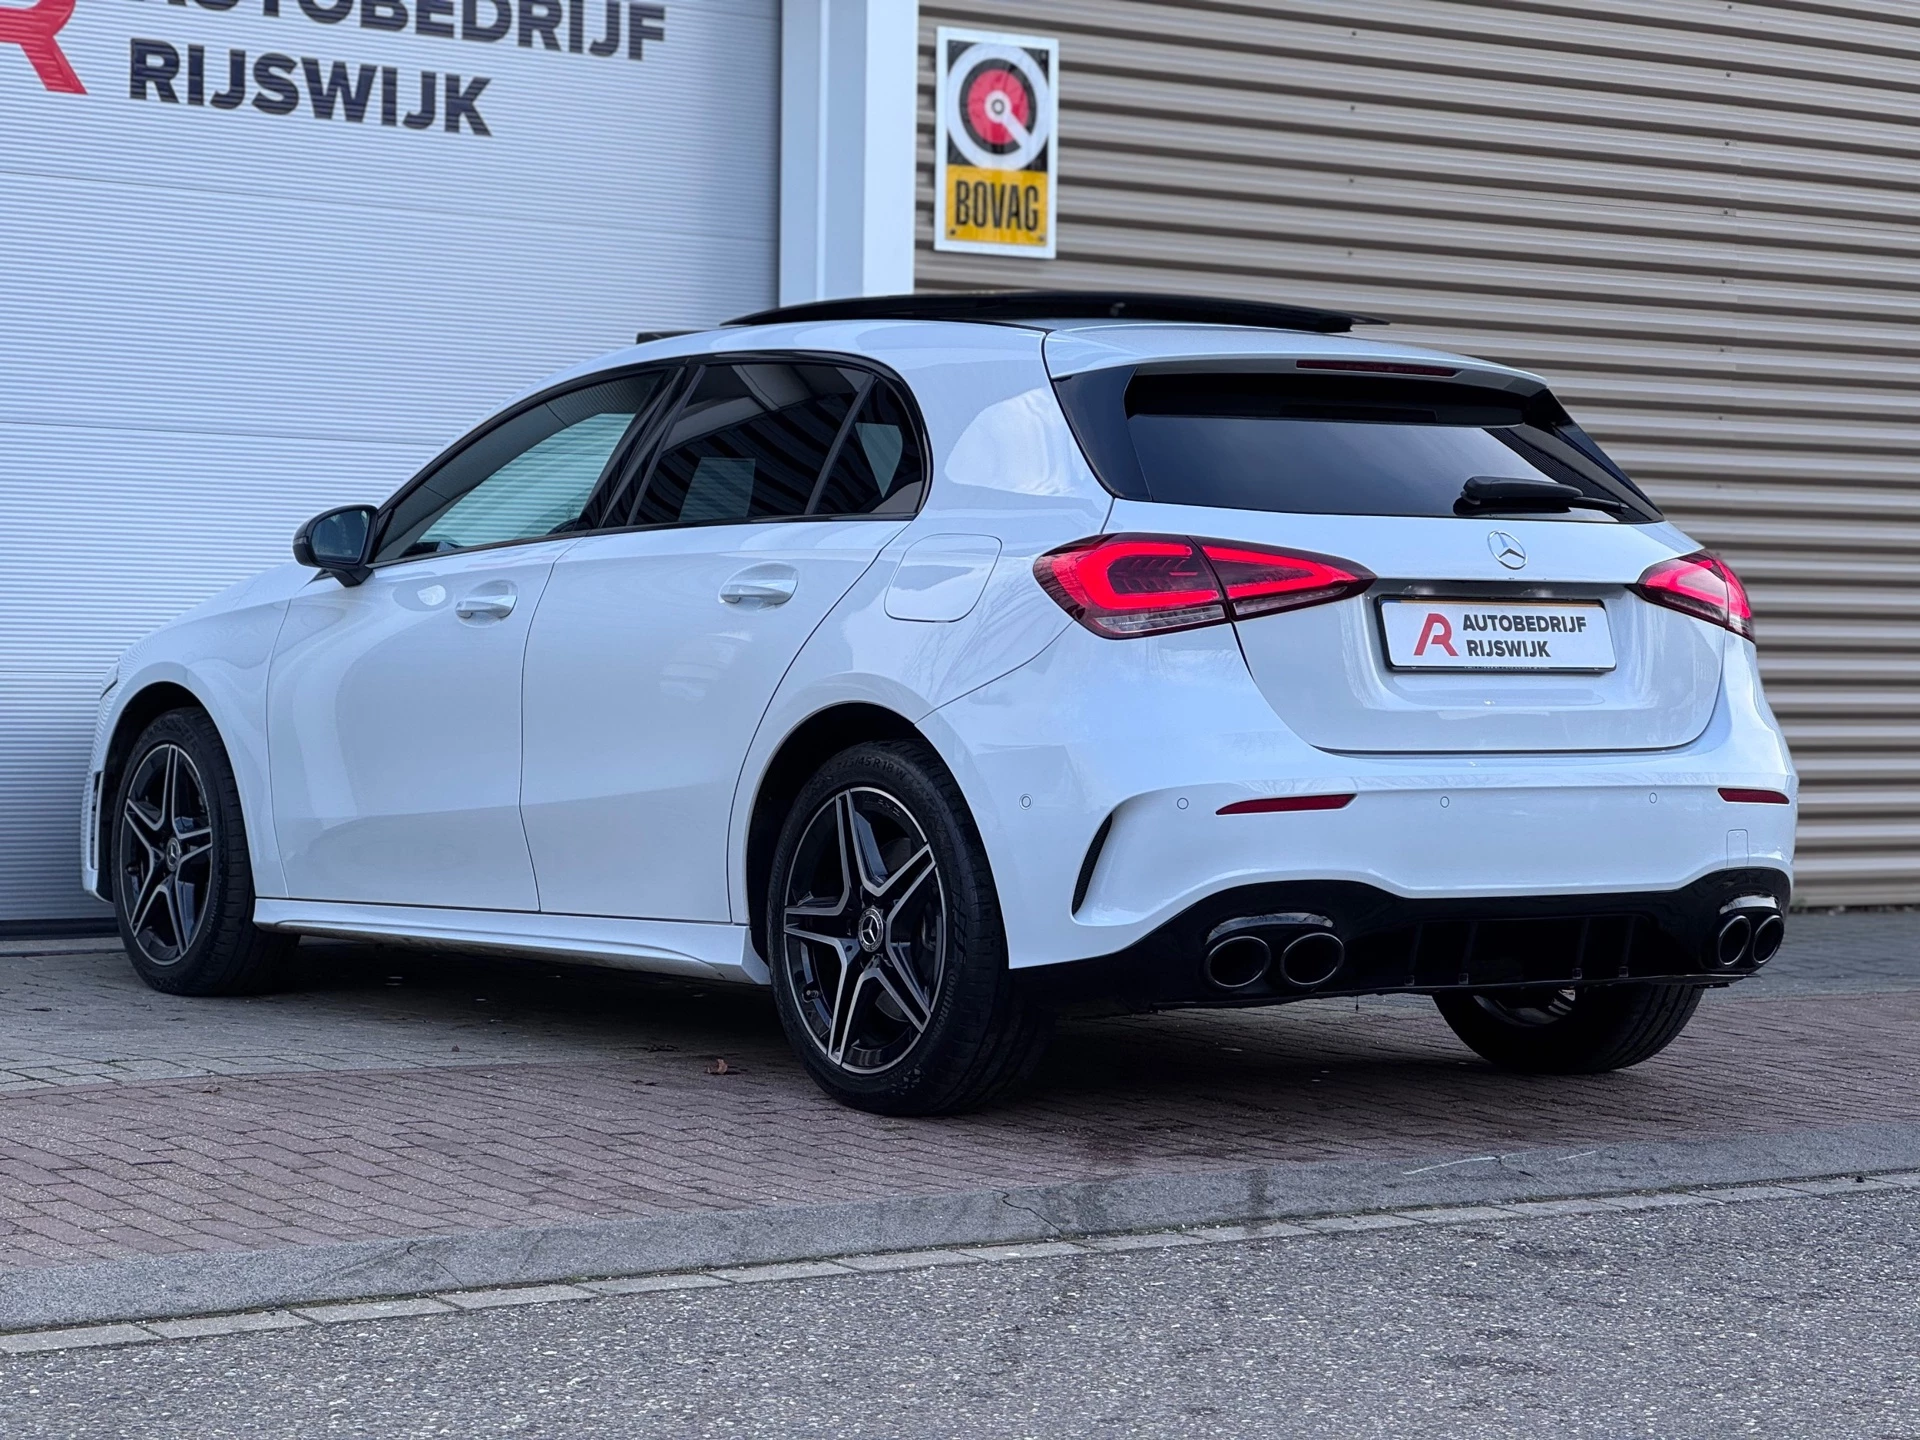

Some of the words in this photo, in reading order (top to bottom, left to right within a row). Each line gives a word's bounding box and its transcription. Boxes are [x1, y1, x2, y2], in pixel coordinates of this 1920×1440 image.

[133, 0, 666, 61] BEDRIJF
[129, 38, 494, 137] RIJSWIJK
[955, 180, 1039, 232] BOVAG
[1462, 614, 1587, 633] AUTOBEDRIJF
[1465, 640, 1552, 658] RIJSWIJK
